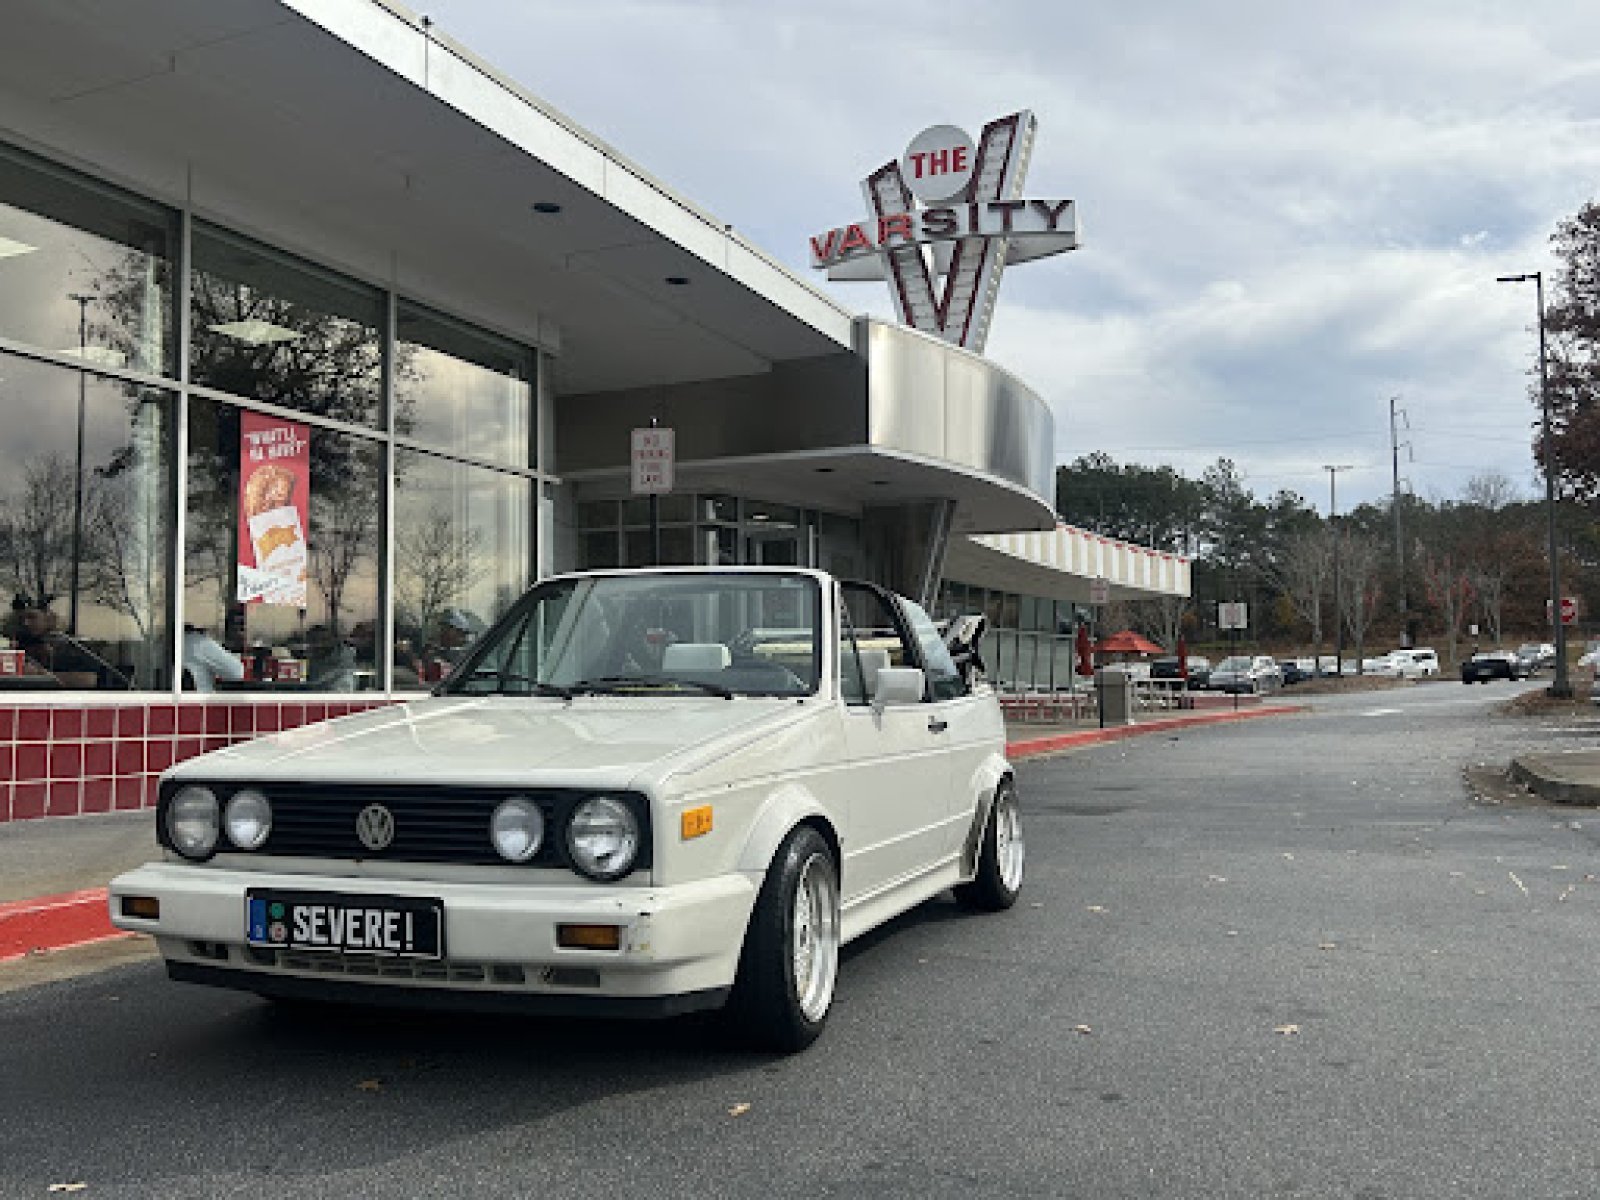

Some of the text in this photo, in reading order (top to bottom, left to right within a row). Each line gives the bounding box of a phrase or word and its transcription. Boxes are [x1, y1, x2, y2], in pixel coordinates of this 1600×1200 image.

[909, 146, 969, 179] THE
[808, 199, 1076, 262] VARSITY
[293, 905, 415, 950] SEVERE!
